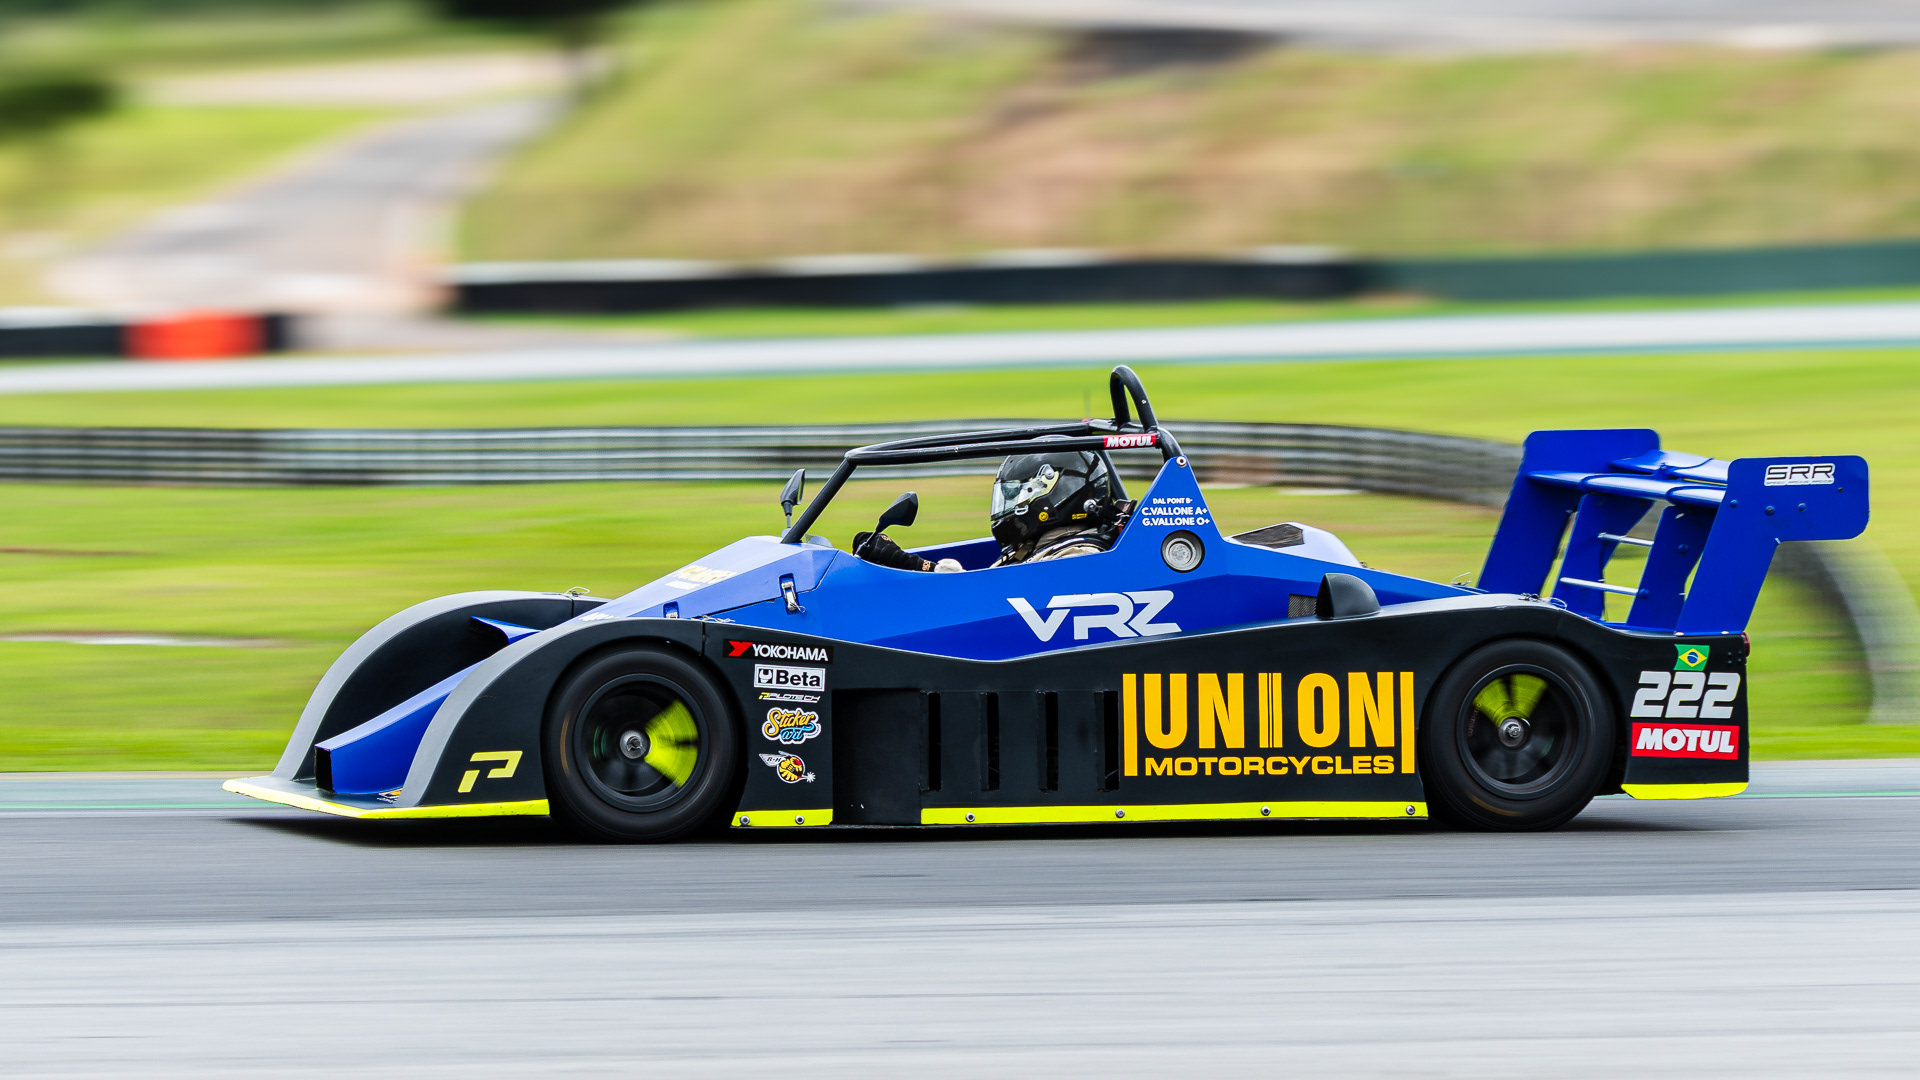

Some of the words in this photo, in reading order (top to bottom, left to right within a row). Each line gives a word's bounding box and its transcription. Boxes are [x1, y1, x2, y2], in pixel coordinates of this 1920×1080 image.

[1106, 435, 1154, 448] MOTUL
[1766, 465, 1833, 480] SRR
[1141, 506, 1194, 516] C.VALLONE
[1194, 506, 1208, 515] A+
[1142, 517, 1195, 526] G.VALLONE
[1196, 517, 1210, 526] O+
[1007, 590, 1182, 642] VRZ
[752, 644, 828, 662] YOKOHAMA
[776, 669, 821, 687] Beta
[1630, 671, 1741, 719] 222
[1143, 672, 1395, 749] UNION
[764, 709, 815, 736] Sticker
[780, 723, 814, 740] art
[1635, 727, 1735, 753] MOTUL
[1145, 755, 1395, 776] MOTORCYCLES
